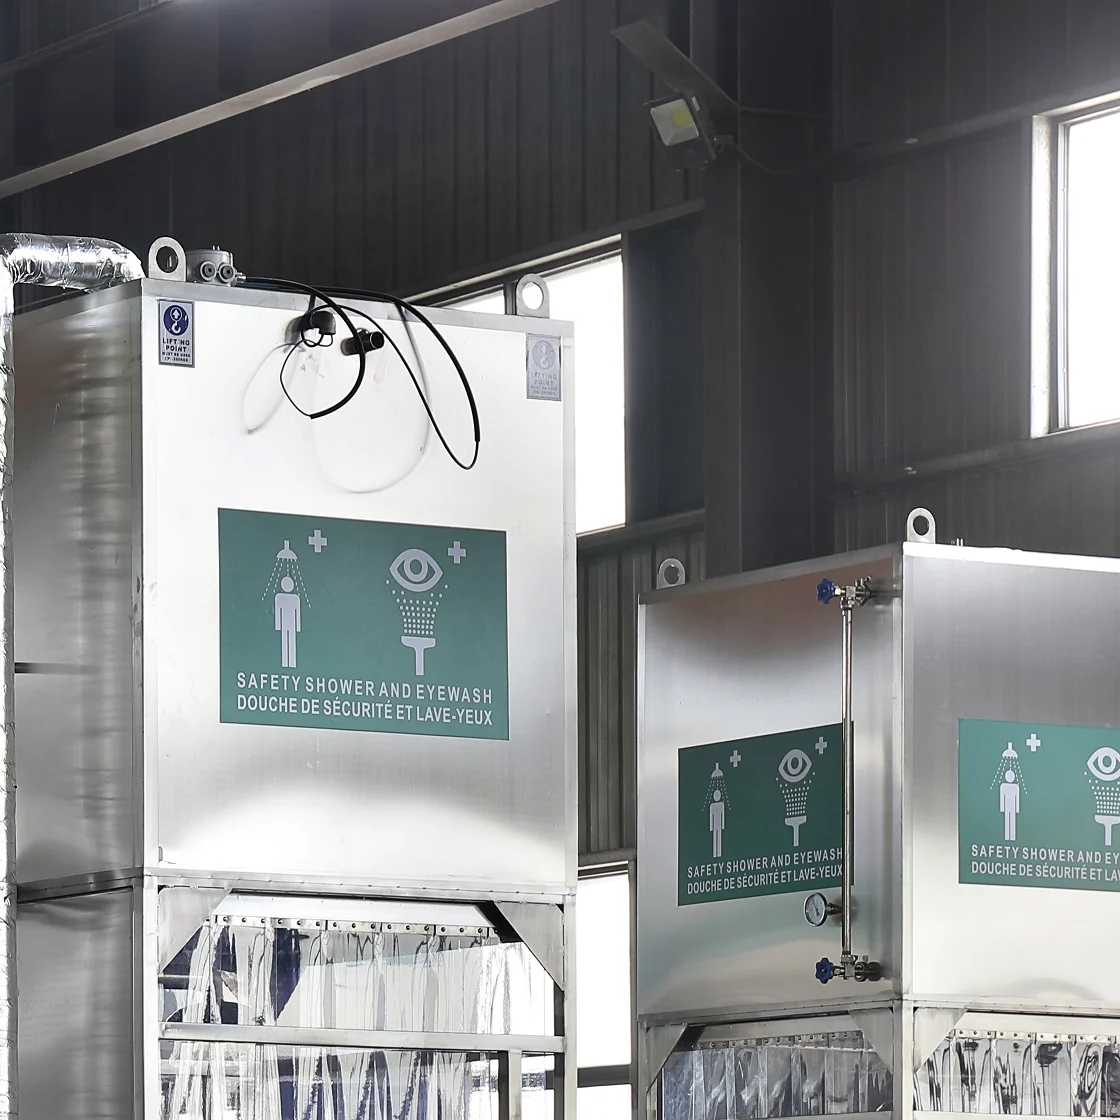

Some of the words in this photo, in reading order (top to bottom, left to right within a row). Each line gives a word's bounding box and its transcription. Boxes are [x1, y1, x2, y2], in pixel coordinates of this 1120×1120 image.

[166, 345, 187, 353] POINT
[237, 671, 301, 692] SAFETY
[305, 676, 375, 697] SHOWER
[379, 682, 412, 699] AND
[416, 684, 493, 704] EYEWASH
[237, 694, 298, 714] DOUCHE
[301, 698, 320, 715] DE
[323, 696, 393, 719] SÉCURITÉ
[396, 704, 413, 721] ET
[416, 705, 493, 726] LAVE-YEUX
[687, 863, 724, 879] SAFETY
[726, 856, 769, 873] SHOWER
[771, 854, 790, 868] AND
[793, 847, 843, 865] EYEWASH
[971, 844, 1019, 859] SAFETY
[1022, 847, 1074, 862] SHOWER
[1077, 850, 1102, 864] AND
[687, 879, 722, 894] DOUCHE
[723, 877, 735, 890] DE
[736, 869, 779, 889] SÉCURITÉ
[781, 870, 792, 883] ET
[793, 864, 843, 881] LAVE-YEUX
[971, 861, 1017, 876] DOUCHE
[1019, 864, 1033, 876] DE
[1035, 862, 1087, 880] SÉCURITÉ
[1090, 868, 1102, 880] ET
